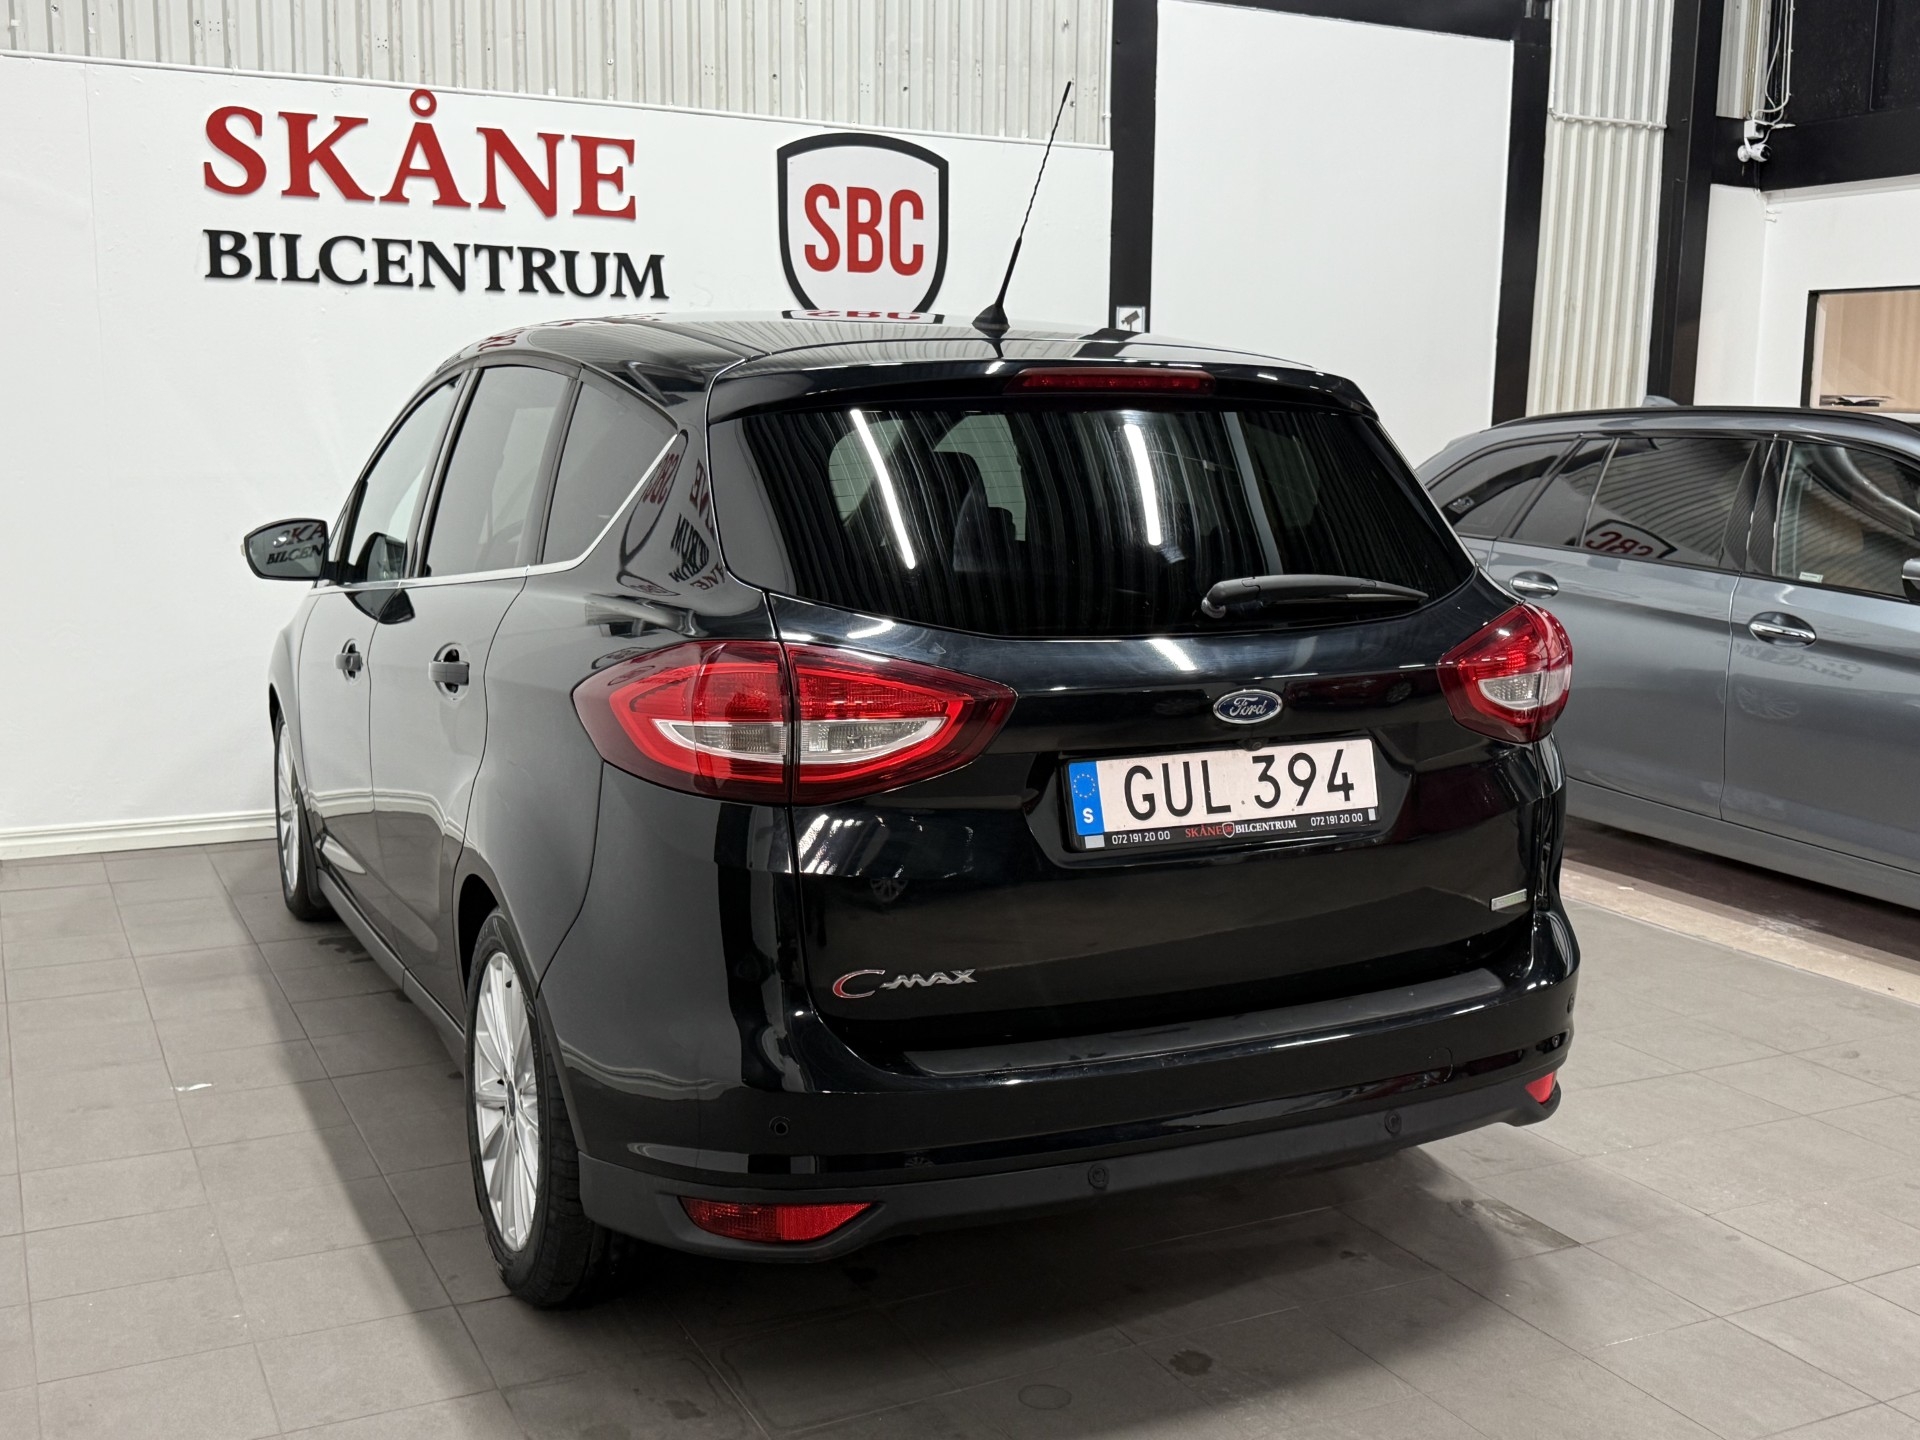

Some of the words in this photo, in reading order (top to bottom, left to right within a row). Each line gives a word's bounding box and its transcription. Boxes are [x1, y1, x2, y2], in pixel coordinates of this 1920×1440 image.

[203, 88, 637, 221] SKÅNE
[203, 228, 670, 300] BILCENTRUM
[803, 182, 925, 277] SBC
[1229, 696, 1267, 717] Ford
[1082, 808, 1094, 824] S
[1124, 759, 1231, 821] GUL
[1252, 748, 1355, 810] 394
[1111, 834, 1128, 845] 072
[1130, 833, 1142, 844] 191
[1144, 831, 1156, 842] 20
[1158, 830, 1171, 841] 00
[1184, 823, 1223, 838] SKÅNE
[1235, 819, 1297, 834] BILCENTRUM
[1310, 816, 1326, 827] 072
[1326, 815, 1338, 825] 191
[1339, 813, 1350, 823] 20
[1351, 812, 1363, 822] 00
